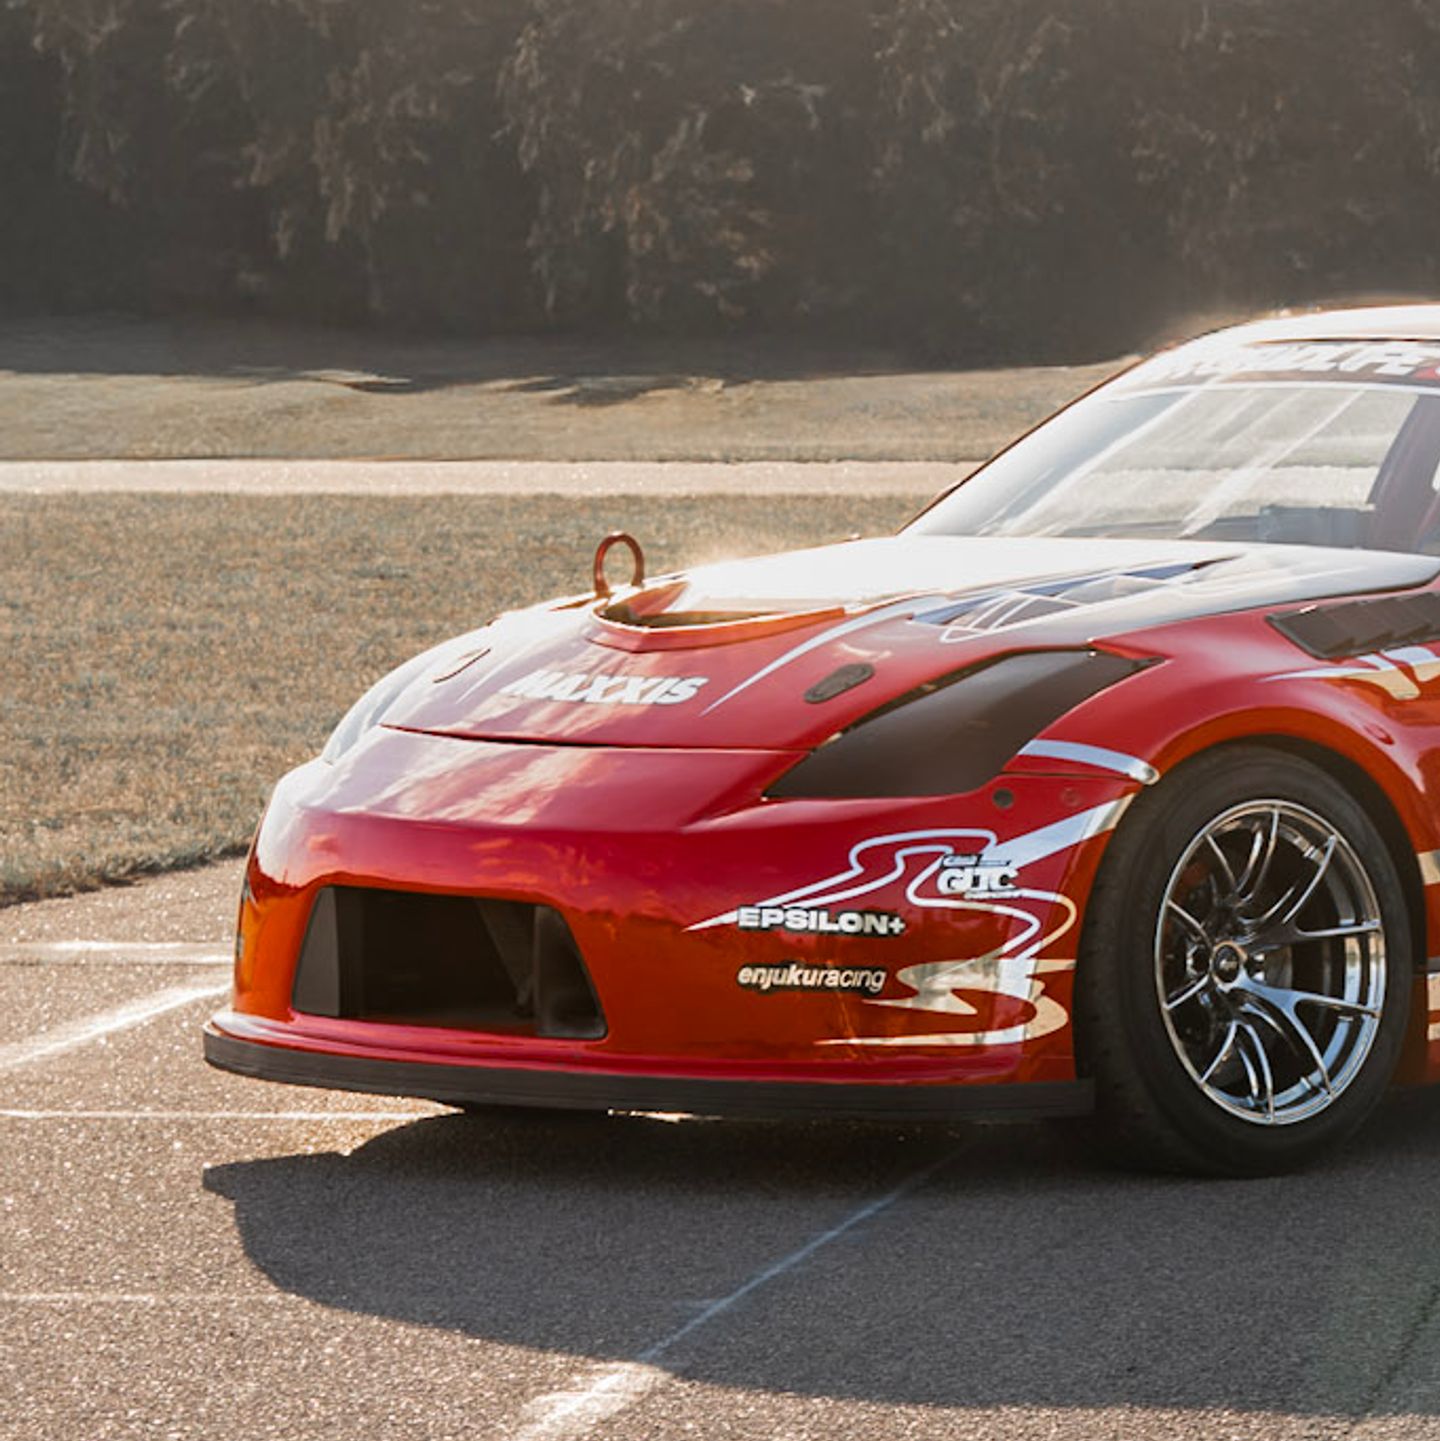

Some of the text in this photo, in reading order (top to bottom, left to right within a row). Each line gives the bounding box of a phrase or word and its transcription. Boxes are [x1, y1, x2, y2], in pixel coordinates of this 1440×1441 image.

[499, 670, 709, 705] MAXXIS
[737, 906, 906, 934] EPSILON+
[737, 964, 887, 993] enjukuracing
